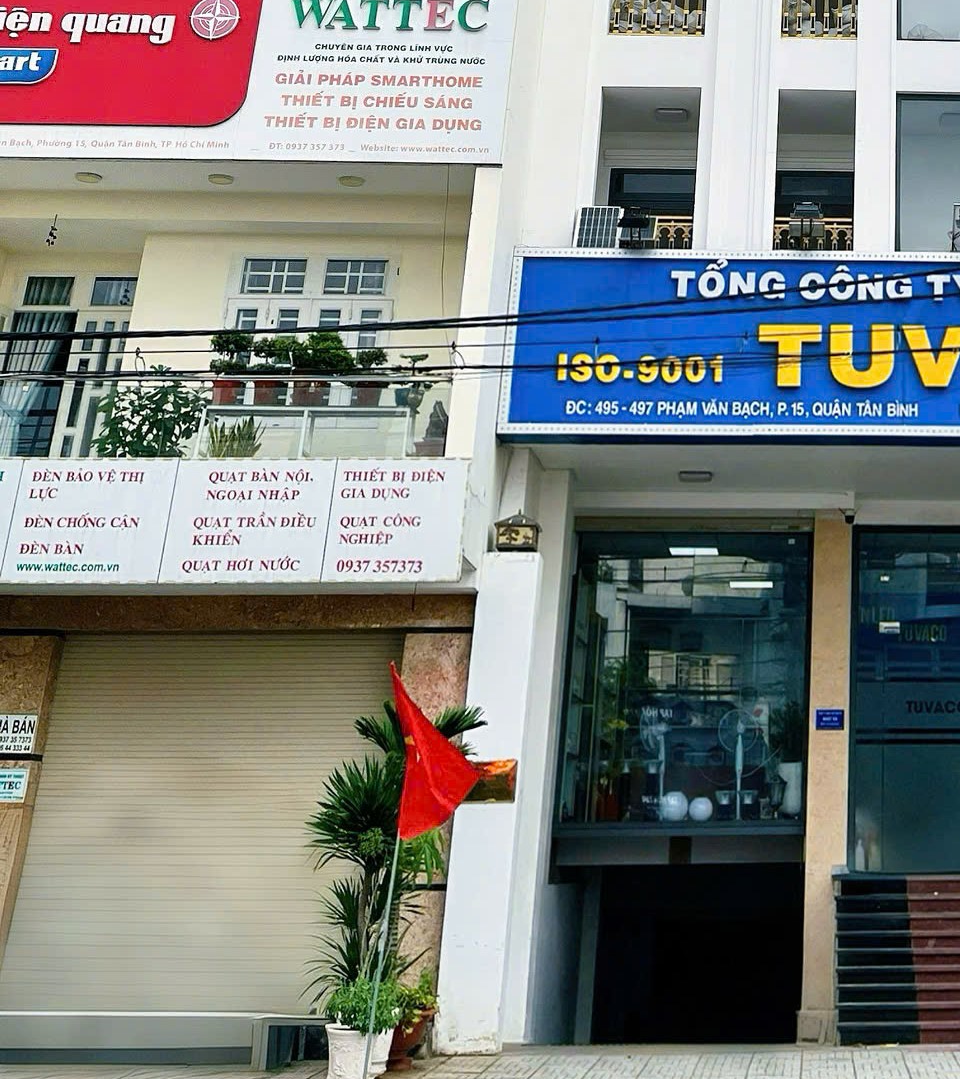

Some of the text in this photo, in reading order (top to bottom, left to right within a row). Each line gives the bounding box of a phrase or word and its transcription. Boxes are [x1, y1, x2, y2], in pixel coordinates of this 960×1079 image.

[61, 12, 176, 45] quang
[314, 42, 354, 51] CHUYÊN
[356, 43, 372, 51] GIA
[375, 44, 407, 52] TRONG
[433, 44, 453, 54] VỰC
[277, 55, 300, 64] ĐỊNH
[303, 54, 335, 64] LƯỢNG
[360, 54, 386, 64] CHẤT
[388, 55, 400, 63] VÀ
[426, 55, 457, 65] TRÙNG
[275, 70, 484, 88] GIẢI PHÁP SMARTHOME
[281, 91, 473, 110] THIẾT BỊ CHIẾU SÁNG
[264, 112, 482, 134] THIẾT BỊ ĐIỆN GIA DỤNG
[207, 140, 230, 149] Minh
[285, 143, 308, 151] 0937
[310, 143, 326, 151] 357
[329, 143, 345, 151] 373
[360, 144, 398, 153] Website:
[400, 145, 489, 153] www.wattec.com.vn
[671, 259, 786, 300] TỔNG
[799, 265, 913, 301] CÔNG
[565, 400, 592, 415] ĐC:
[595, 401, 619, 415] 495
[629, 401, 653, 415] 497
[657, 401, 698, 418] PHẠM
[701, 398, 728, 416] VĂN
[732, 401, 774, 419] BẠCH,
[812, 399, 851, 419] QUẬN
[856, 399, 882, 417] TÂN
[887, 400, 919, 417] BÌNH
[32, 468, 144, 484] ĐÈN BẢO VỆ THỊ
[209, 468, 280, 484] QUẠT BÀN
[344, 467, 446, 484] THIẾT BỊ ĐIỆN
[29, 487, 58, 501] LỰC
[206, 487, 300, 502] NGOẠI NHẬP
[341, 488, 410, 500] GIA DỤNG
[24, 512, 140, 530] ĐÈN CHỐNG CẬN
[193, 512, 317, 530] QUẠT TRẦN ĐIỀU
[340, 513, 421, 529] QUẠT CÔNG
[192, 529, 241, 546] KHIỂN
[339, 531, 393, 546] NGHIỆP
[19, 540, 84, 554] ĐÈN BÀN
[16, 562, 119, 572] www.wattec.com.vn
[182, 556, 301, 573] QUẠT HƠI NƯỚC
[336, 560, 423, 573] 0937 357373
[12, 716, 36, 734] BÁN
